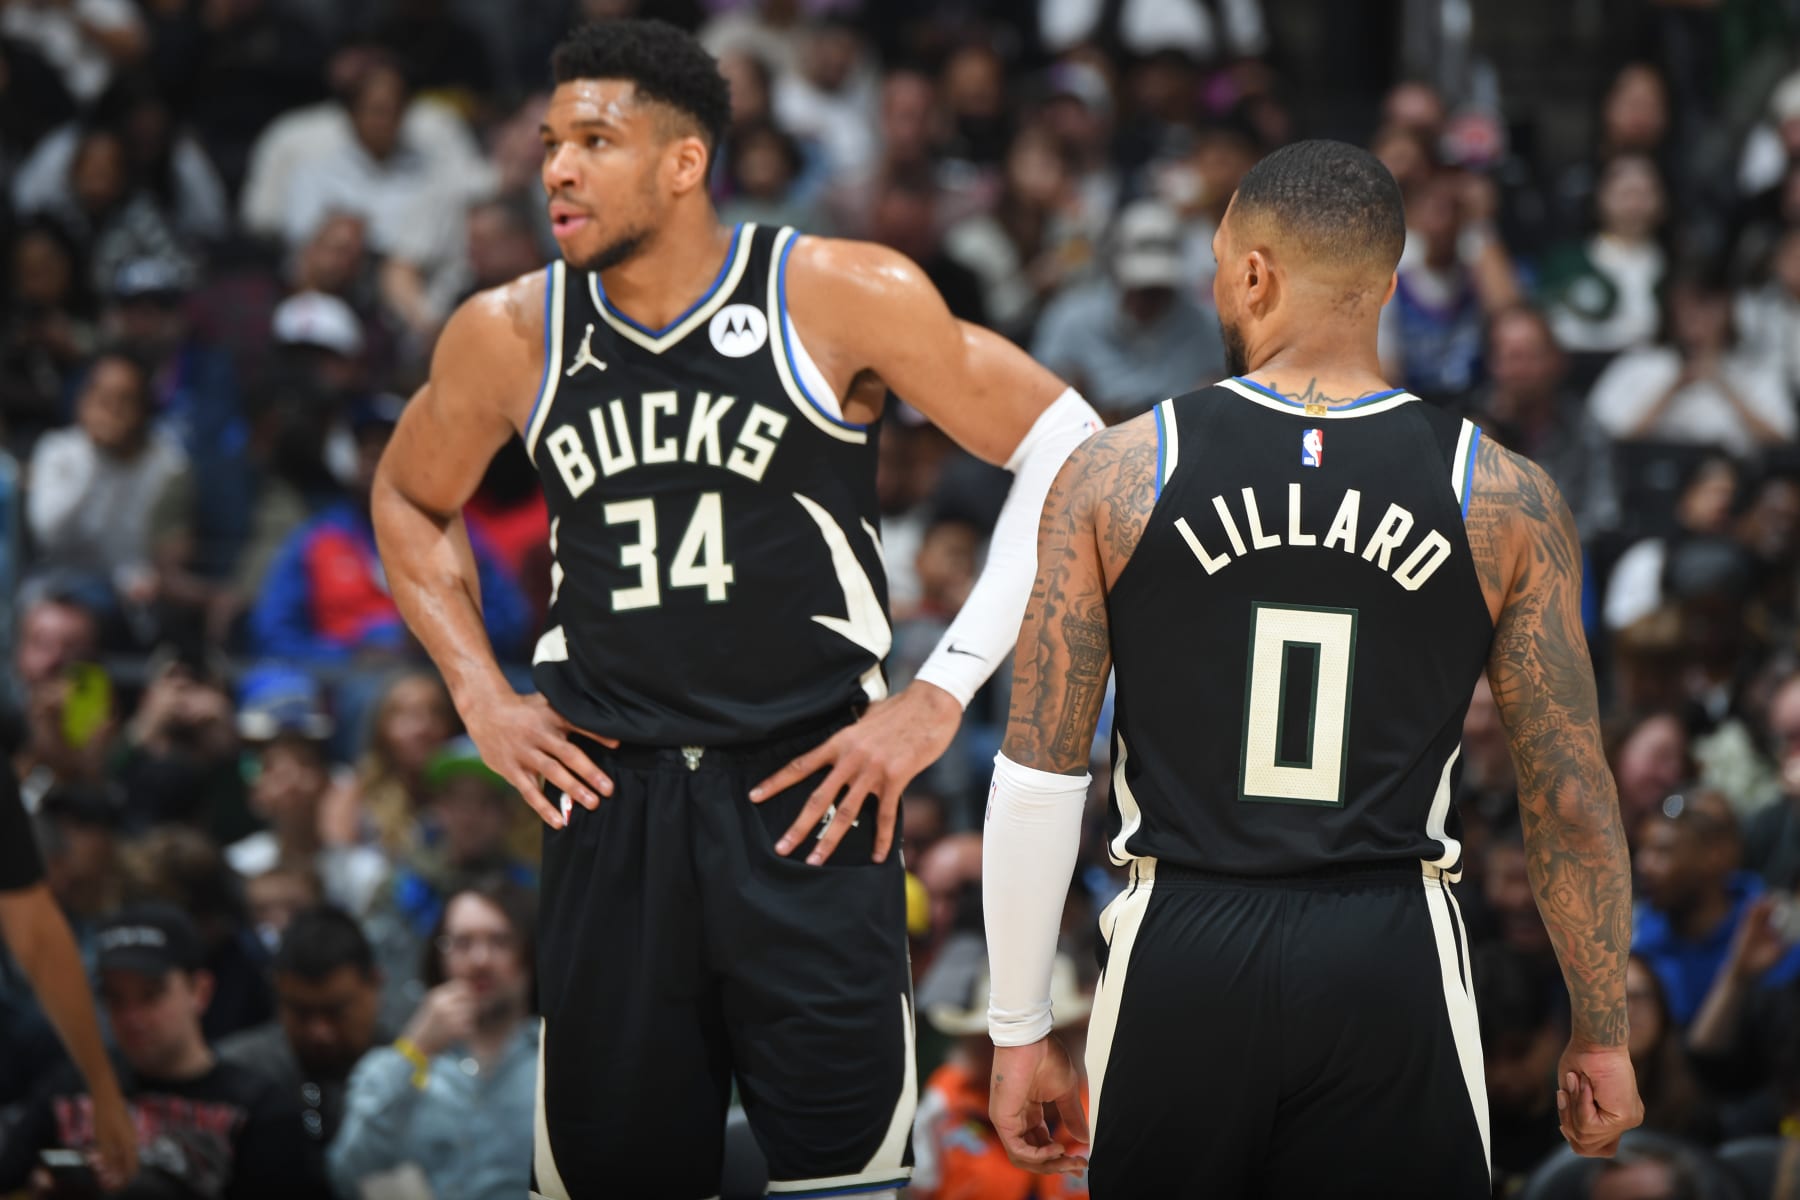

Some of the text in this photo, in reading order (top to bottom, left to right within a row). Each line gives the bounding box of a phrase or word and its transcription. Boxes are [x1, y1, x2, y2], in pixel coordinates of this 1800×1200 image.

[545, 390, 789, 498] BUCKS
[604, 491, 735, 611] 34
[1173, 483, 1451, 591] LILLARD
[1239, 602, 1357, 807] 0
